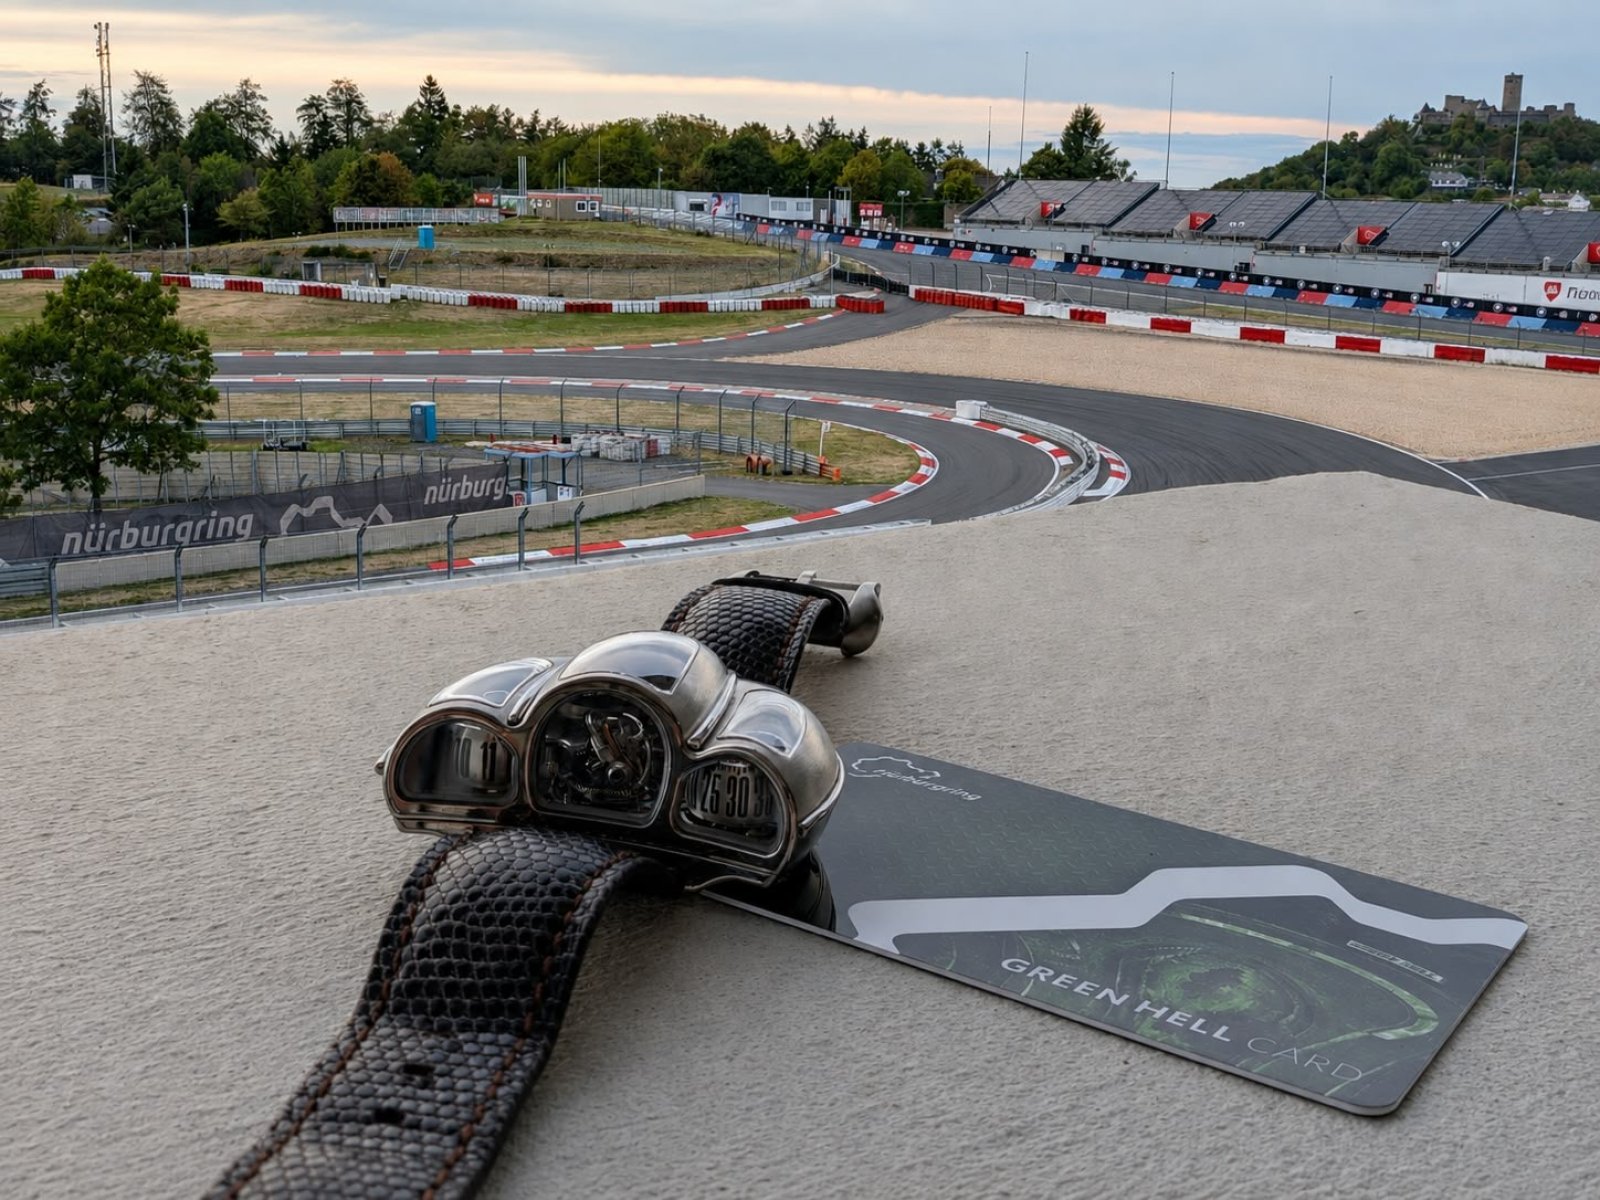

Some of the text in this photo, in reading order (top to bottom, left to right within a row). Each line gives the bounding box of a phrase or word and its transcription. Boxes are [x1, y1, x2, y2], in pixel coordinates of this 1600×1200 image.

[423, 474, 507, 505] nürburg
[61, 510, 254, 555] nürburgring
[725, 775, 751, 819] 30
[1001, 957, 1363, 1082] GREEN HELL CARD
